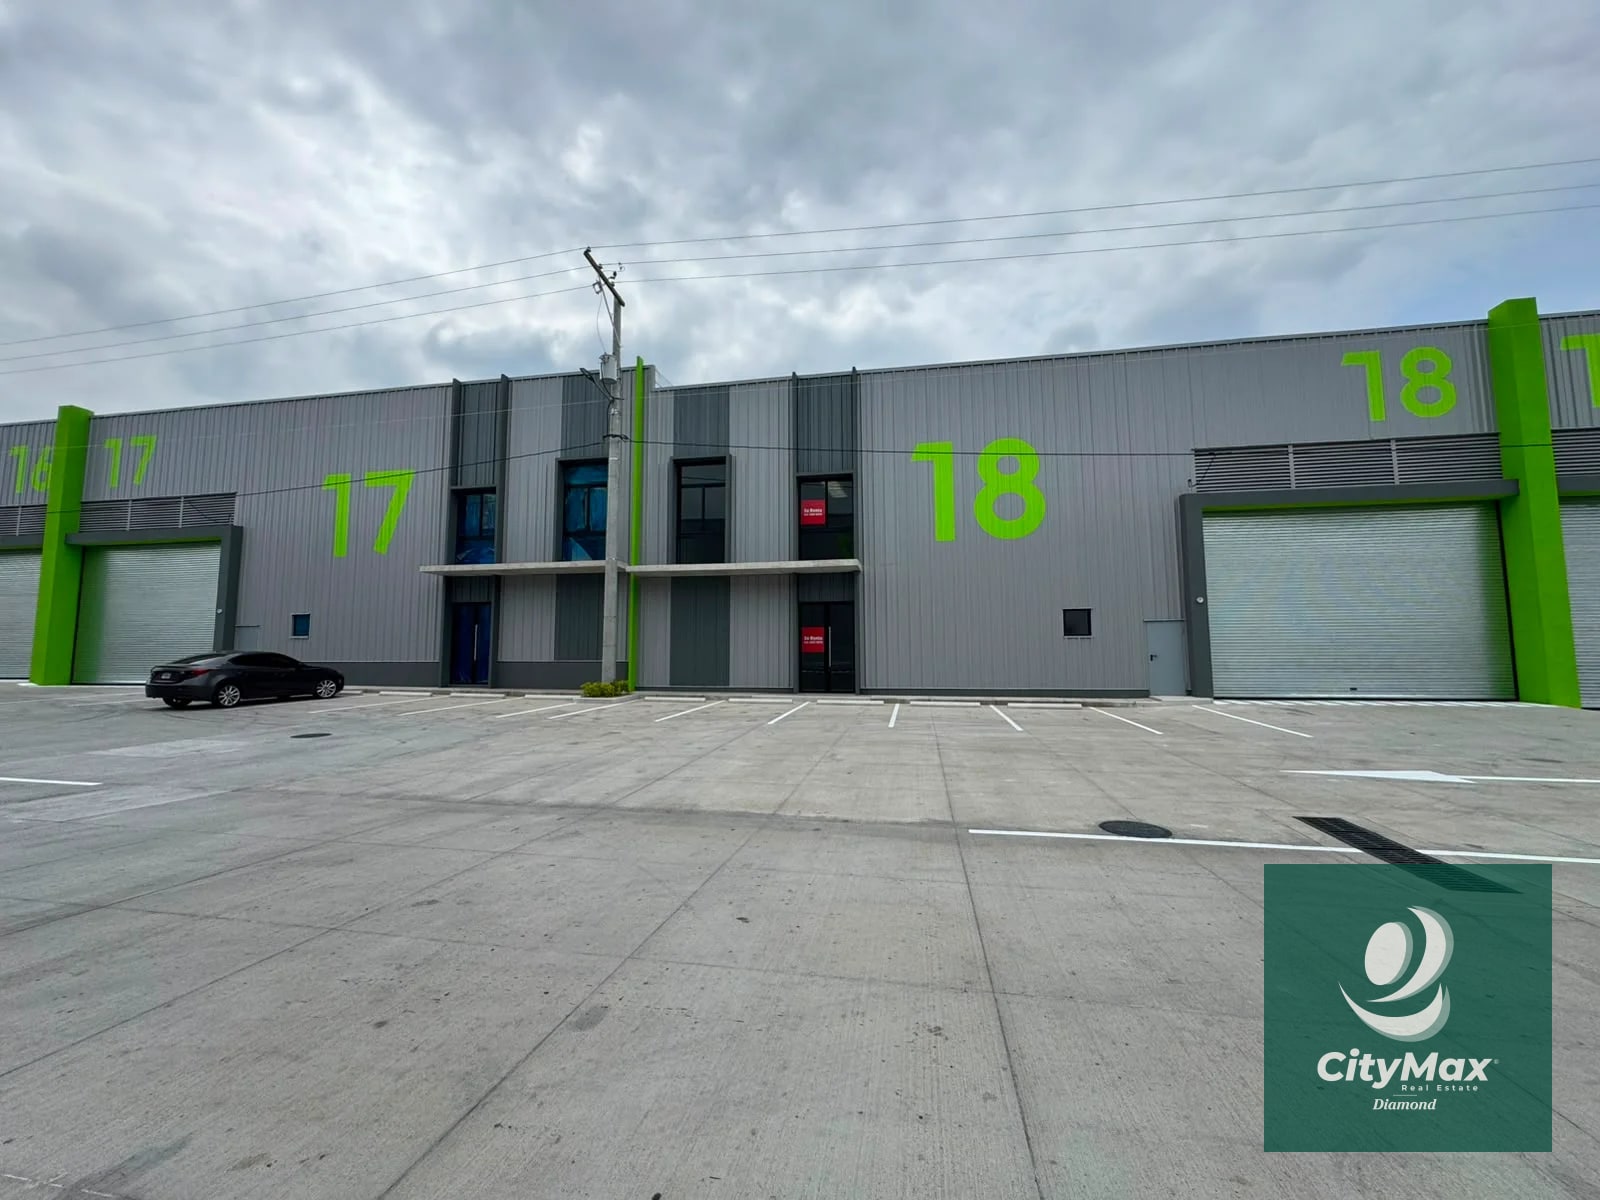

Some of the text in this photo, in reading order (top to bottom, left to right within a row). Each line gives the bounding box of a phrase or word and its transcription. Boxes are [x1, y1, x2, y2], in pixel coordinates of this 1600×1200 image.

[1341, 346, 1457, 422] 18
[9, 444, 53, 494] 16
[103, 434, 157, 489] 17
[911, 436, 1046, 542] 18
[322, 468, 415, 558] 17
